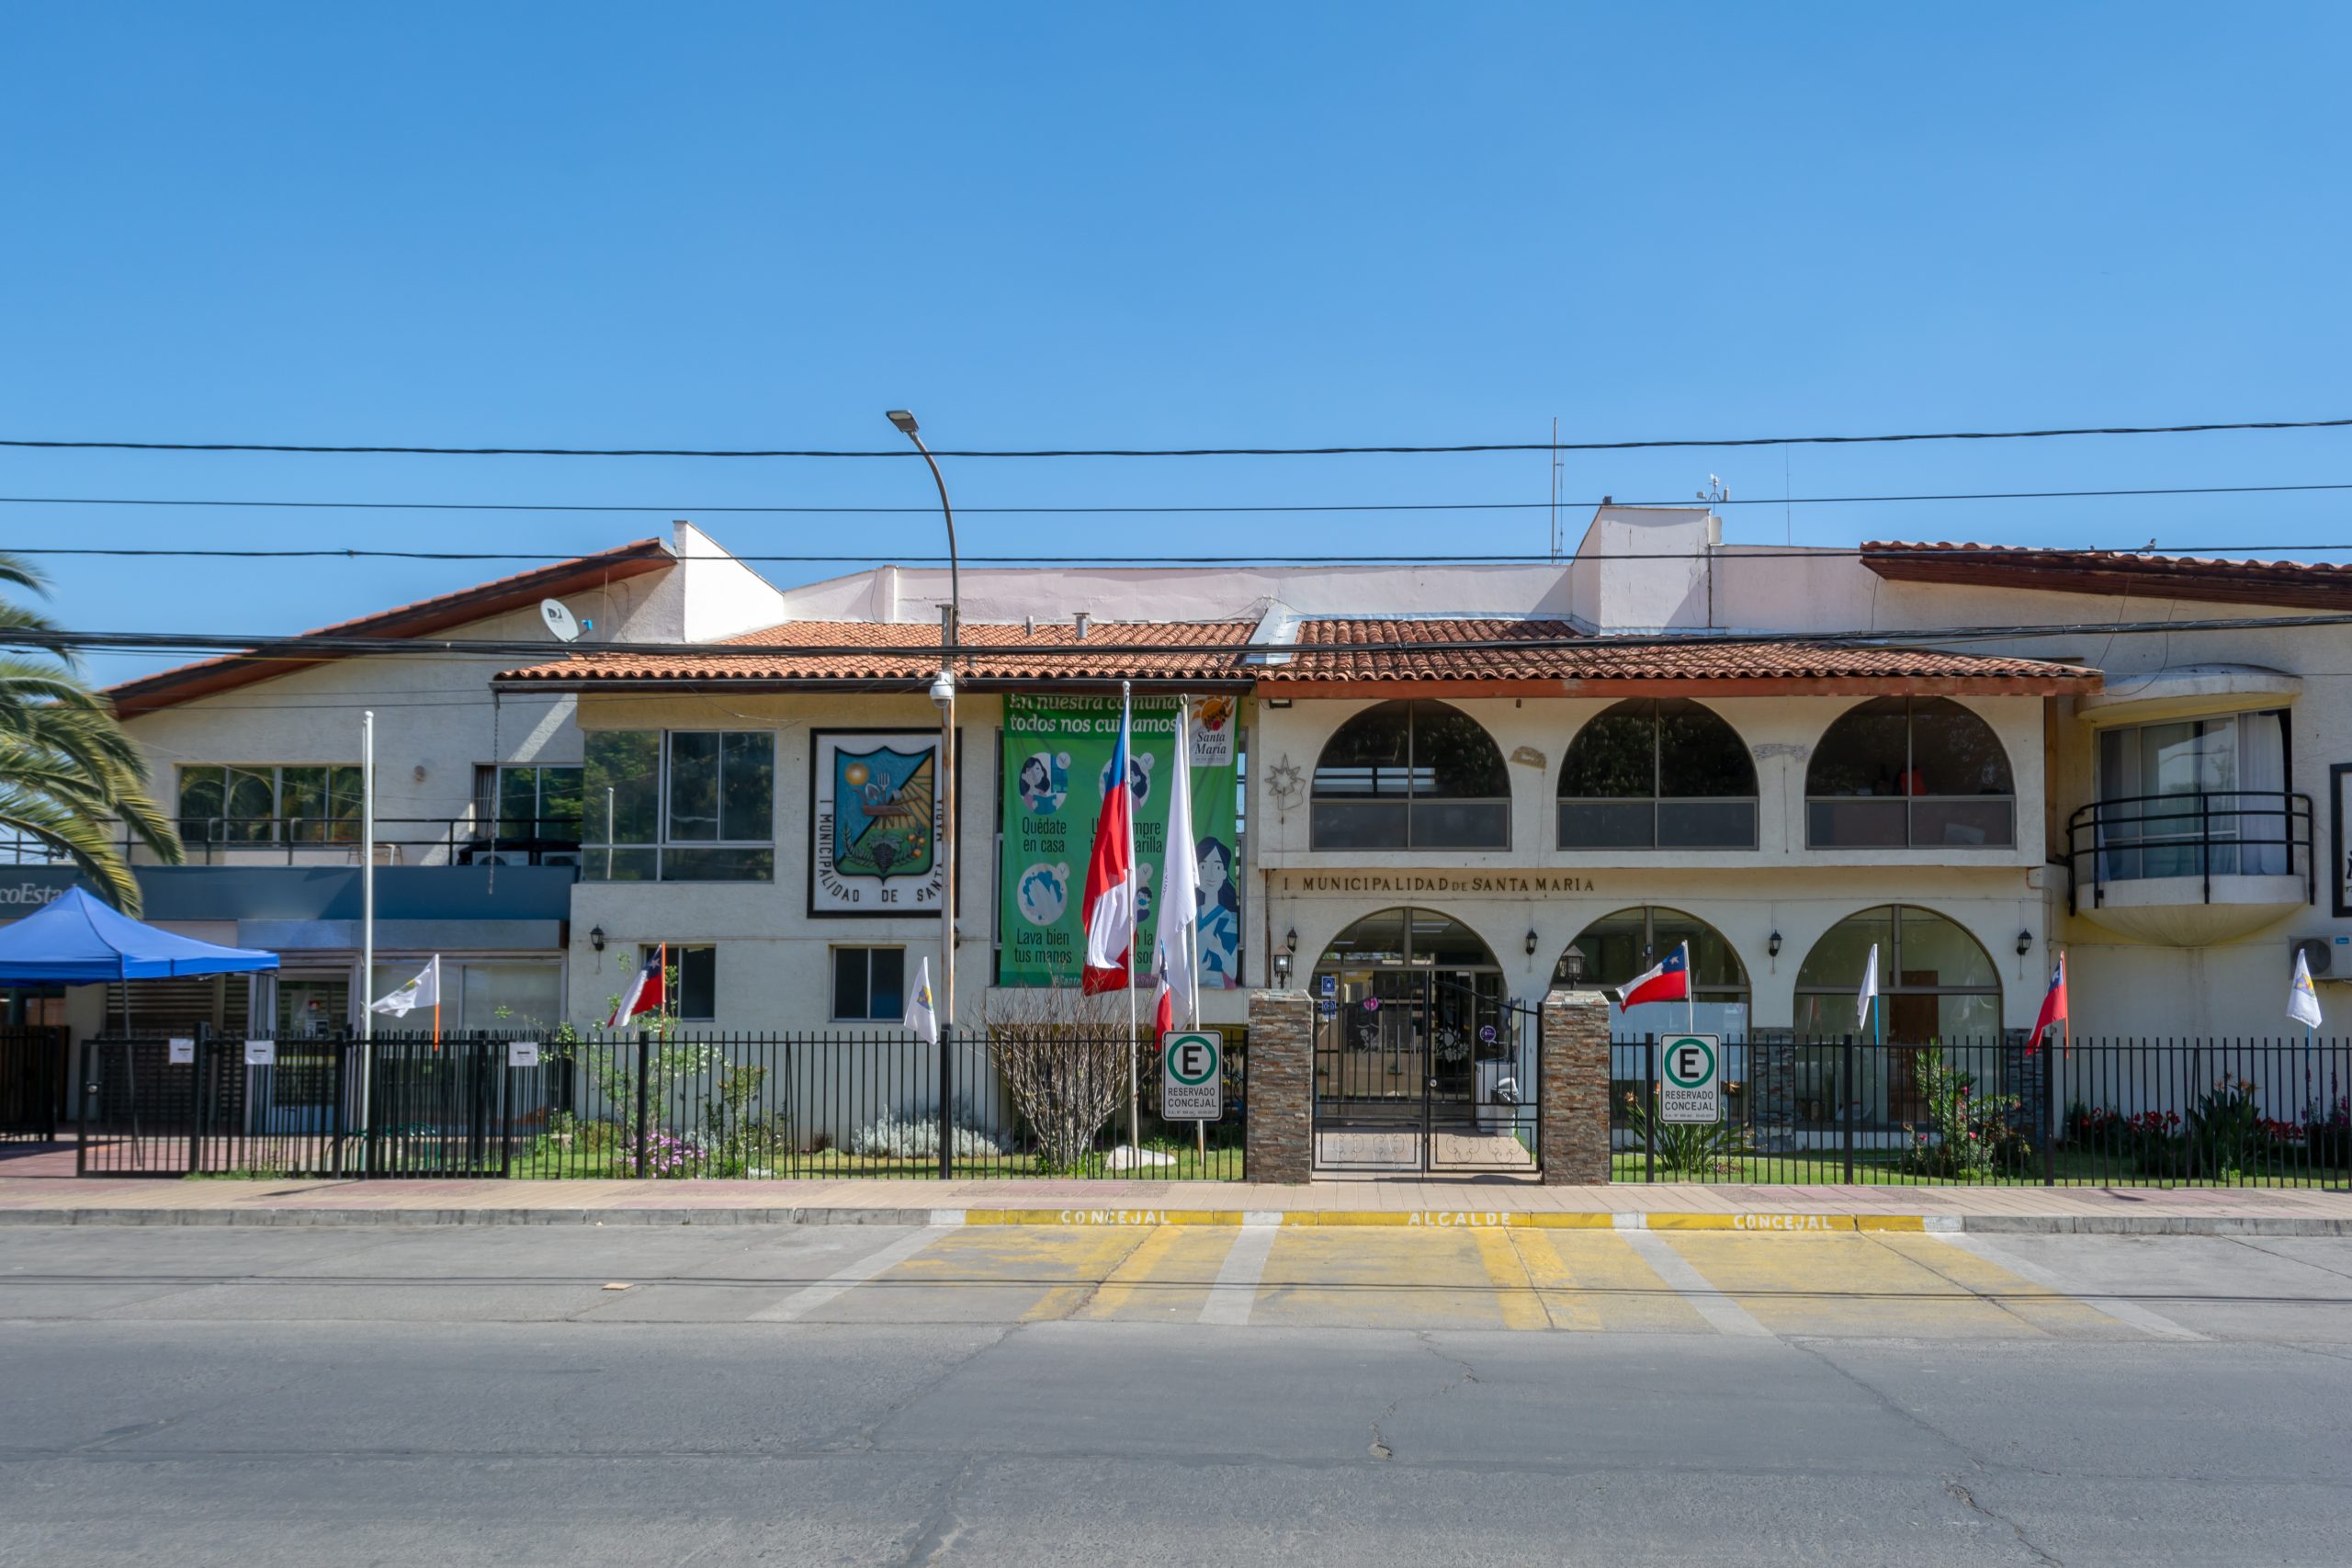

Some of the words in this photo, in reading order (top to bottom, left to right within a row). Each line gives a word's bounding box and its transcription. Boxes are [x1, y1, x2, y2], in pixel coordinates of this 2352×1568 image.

[1036, 695, 1103, 710] nuestra
[1010, 714, 1057, 732] todos
[1061, 718, 1091, 733] nos
[1094, 714, 1177, 733] cuiamos
[1196, 731, 1226, 743] Santa
[1194, 742, 1227, 755] María
[1022, 817, 1067, 836] Quédate
[1023, 840, 1036, 853] en
[1040, 840, 1065, 853] casa
[818, 813, 860, 903] MUNICIPALIDAD
[881, 889, 899, 903] DE
[1303, 876, 1449, 891] MUNICIPALIDAD
[1452, 881, 1468, 892] DE
[1471, 877, 1529, 891] SANTA
[1534, 877, 1595, 892] MARIA
[1016, 929, 1042, 945] Lava
[1046, 928, 1069, 945] bien
[1013, 947, 1032, 964] tus
[1035, 949, 1072, 964] manos
[1182, 1045, 1203, 1076] E
[1679, 1048, 1700, 1078] E
[1168, 1088, 1216, 1096] RESERVADO
[1665, 1090, 1713, 1100] RESERVADO
[1168, 1099, 1216, 1108] CONCEJAL
[1665, 1101, 1714, 1111] CONCEJAL
[1061, 1209, 1171, 1225] CONCEJAL
[1407, 1212, 1512, 1227] ALCALDE
[1733, 1214, 1833, 1231] CONCEJAL
